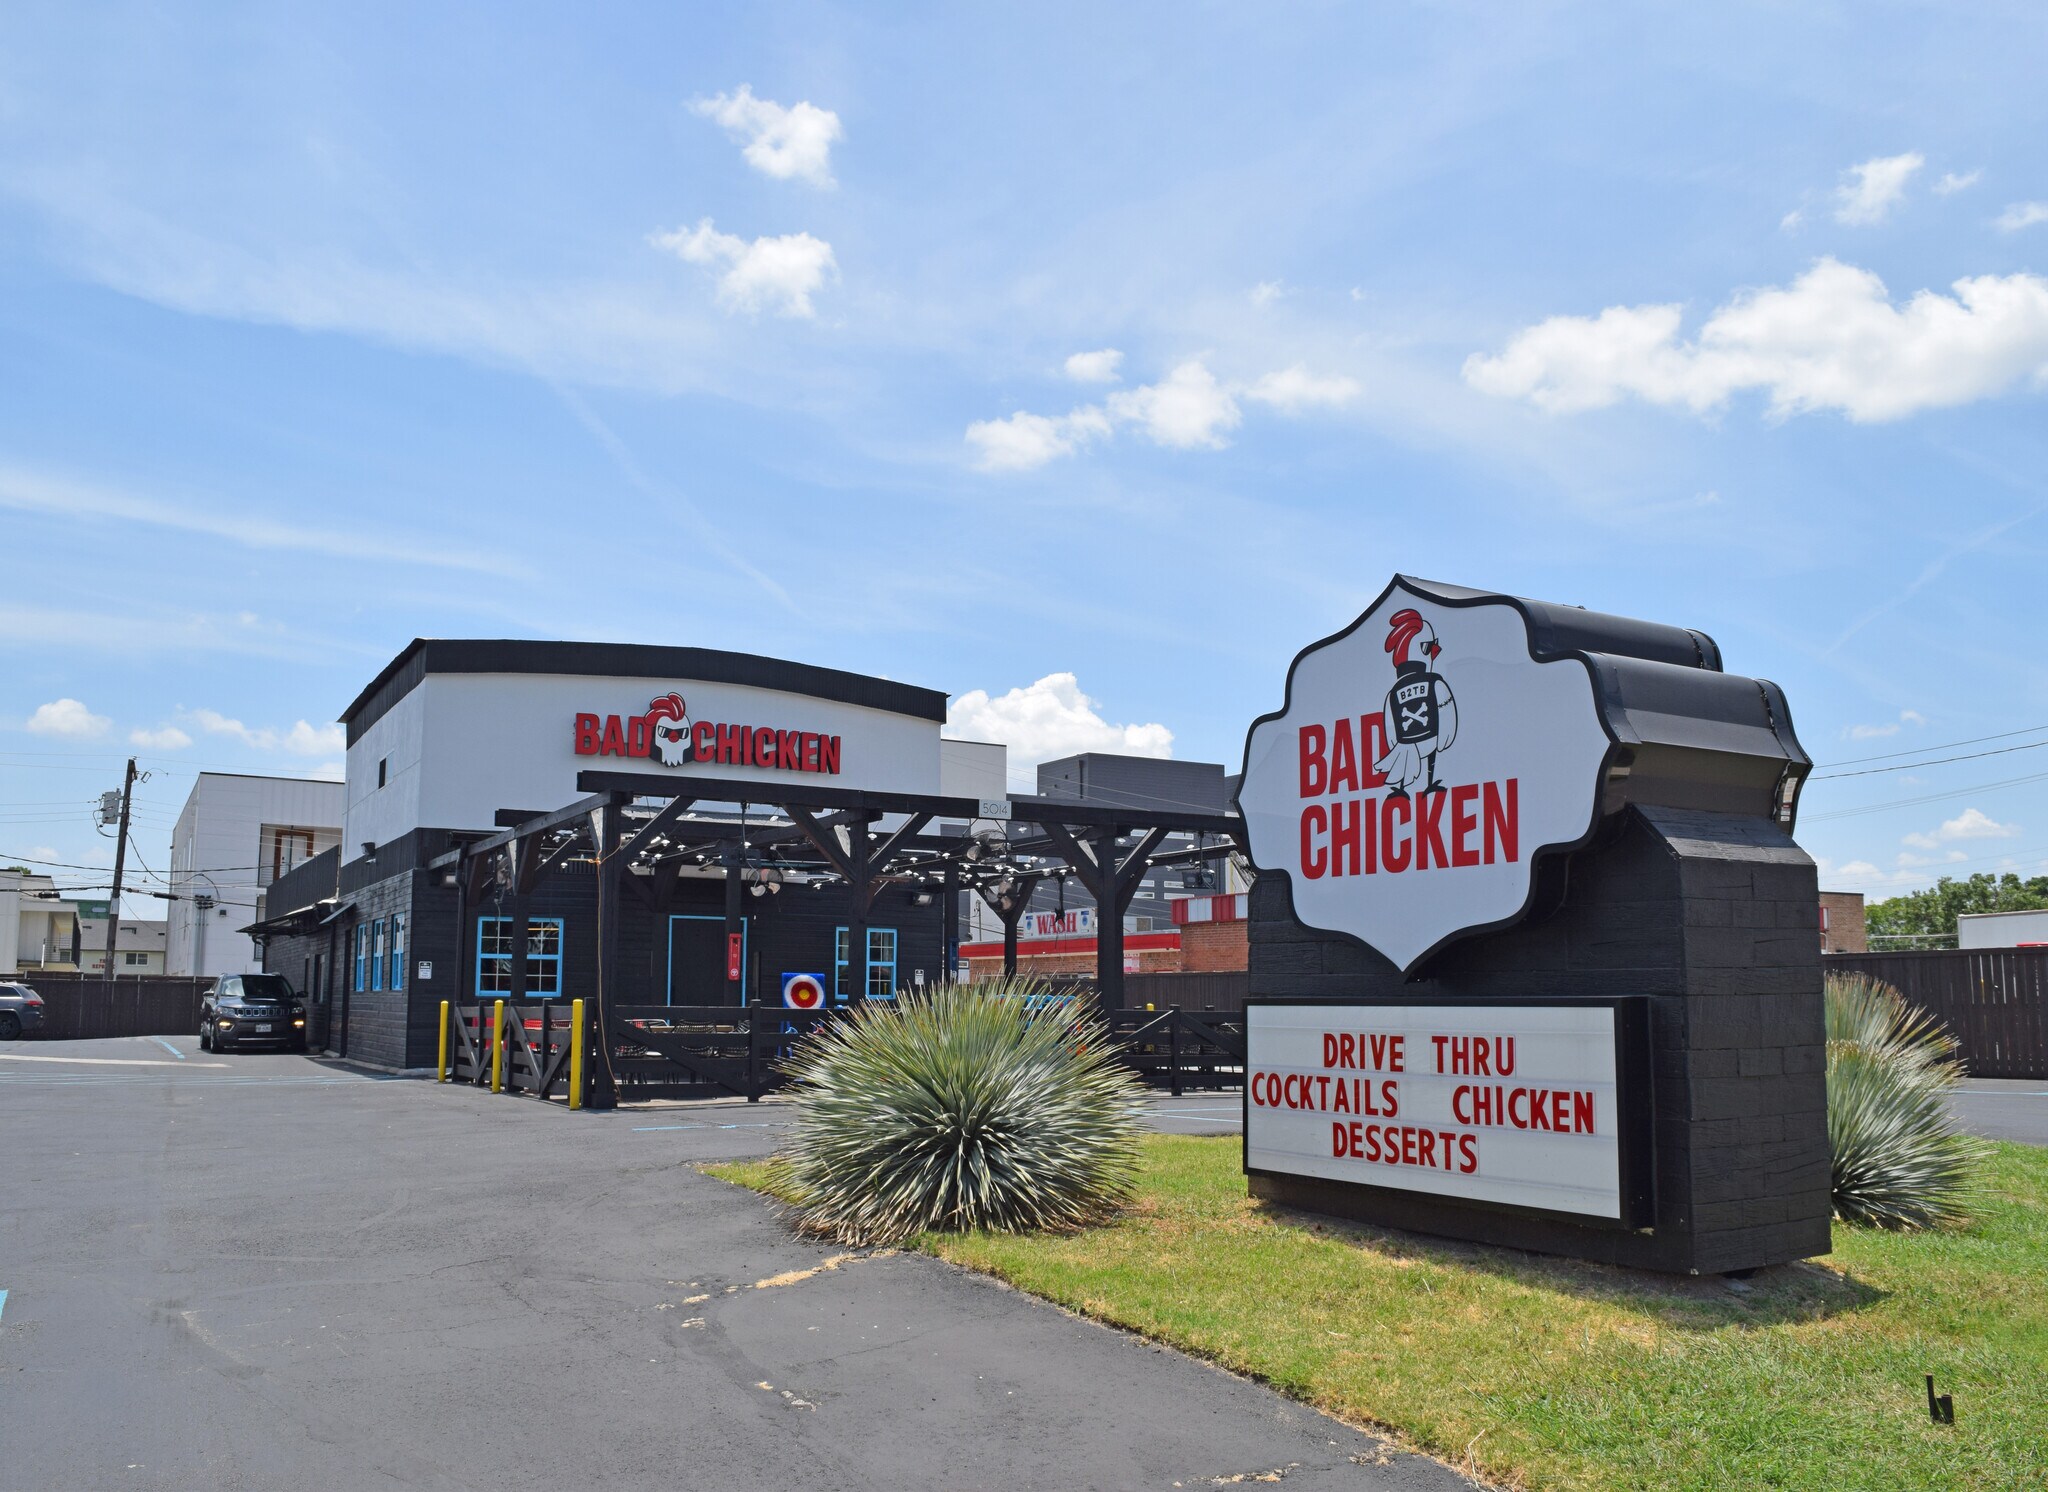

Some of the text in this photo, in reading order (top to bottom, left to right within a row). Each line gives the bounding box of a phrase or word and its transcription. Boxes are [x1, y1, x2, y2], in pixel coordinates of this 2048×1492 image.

[1400, 685, 1426, 700] B2TB
[575, 713, 841, 774] BAD CHICKEN
[1299, 711, 1391, 799] BAD
[983, 803, 1008, 815] 5014
[1300, 778, 1519, 881] CHICKEN
[1323, 1033, 1515, 1077] DRIVE THRU
[1251, 1071, 1595, 1134] COCKTAILS CHICKEN
[1332, 1122, 1478, 1174] DESSERTS
